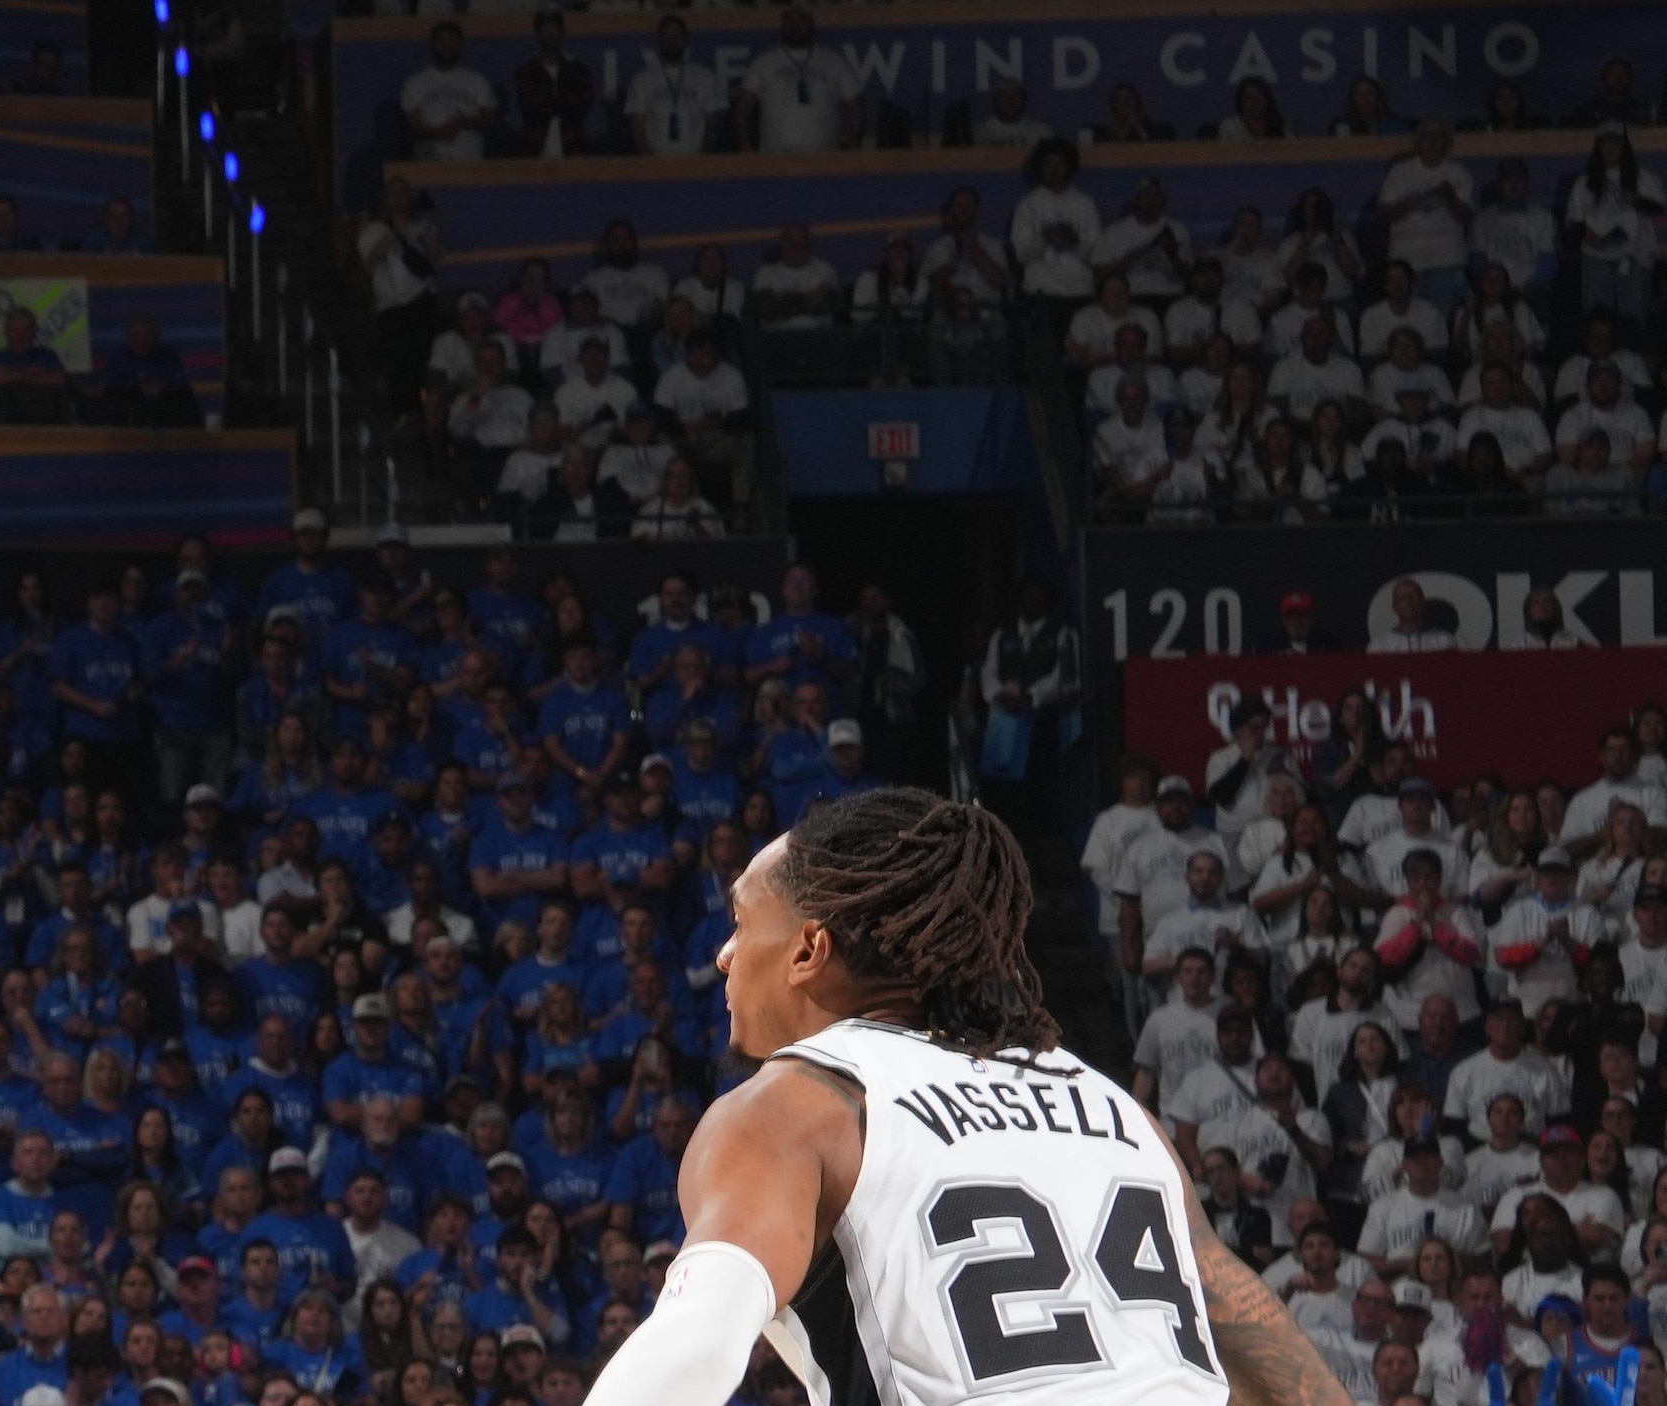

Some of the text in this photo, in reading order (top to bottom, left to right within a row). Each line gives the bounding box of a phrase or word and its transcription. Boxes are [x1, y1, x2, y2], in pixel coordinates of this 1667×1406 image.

[1161, 22, 1540, 86] CASINO
[1103, 587, 1242, 662] 120
[893, 1080, 1141, 1151] VASSELL
[917, 1175, 1227, 1393] 24
